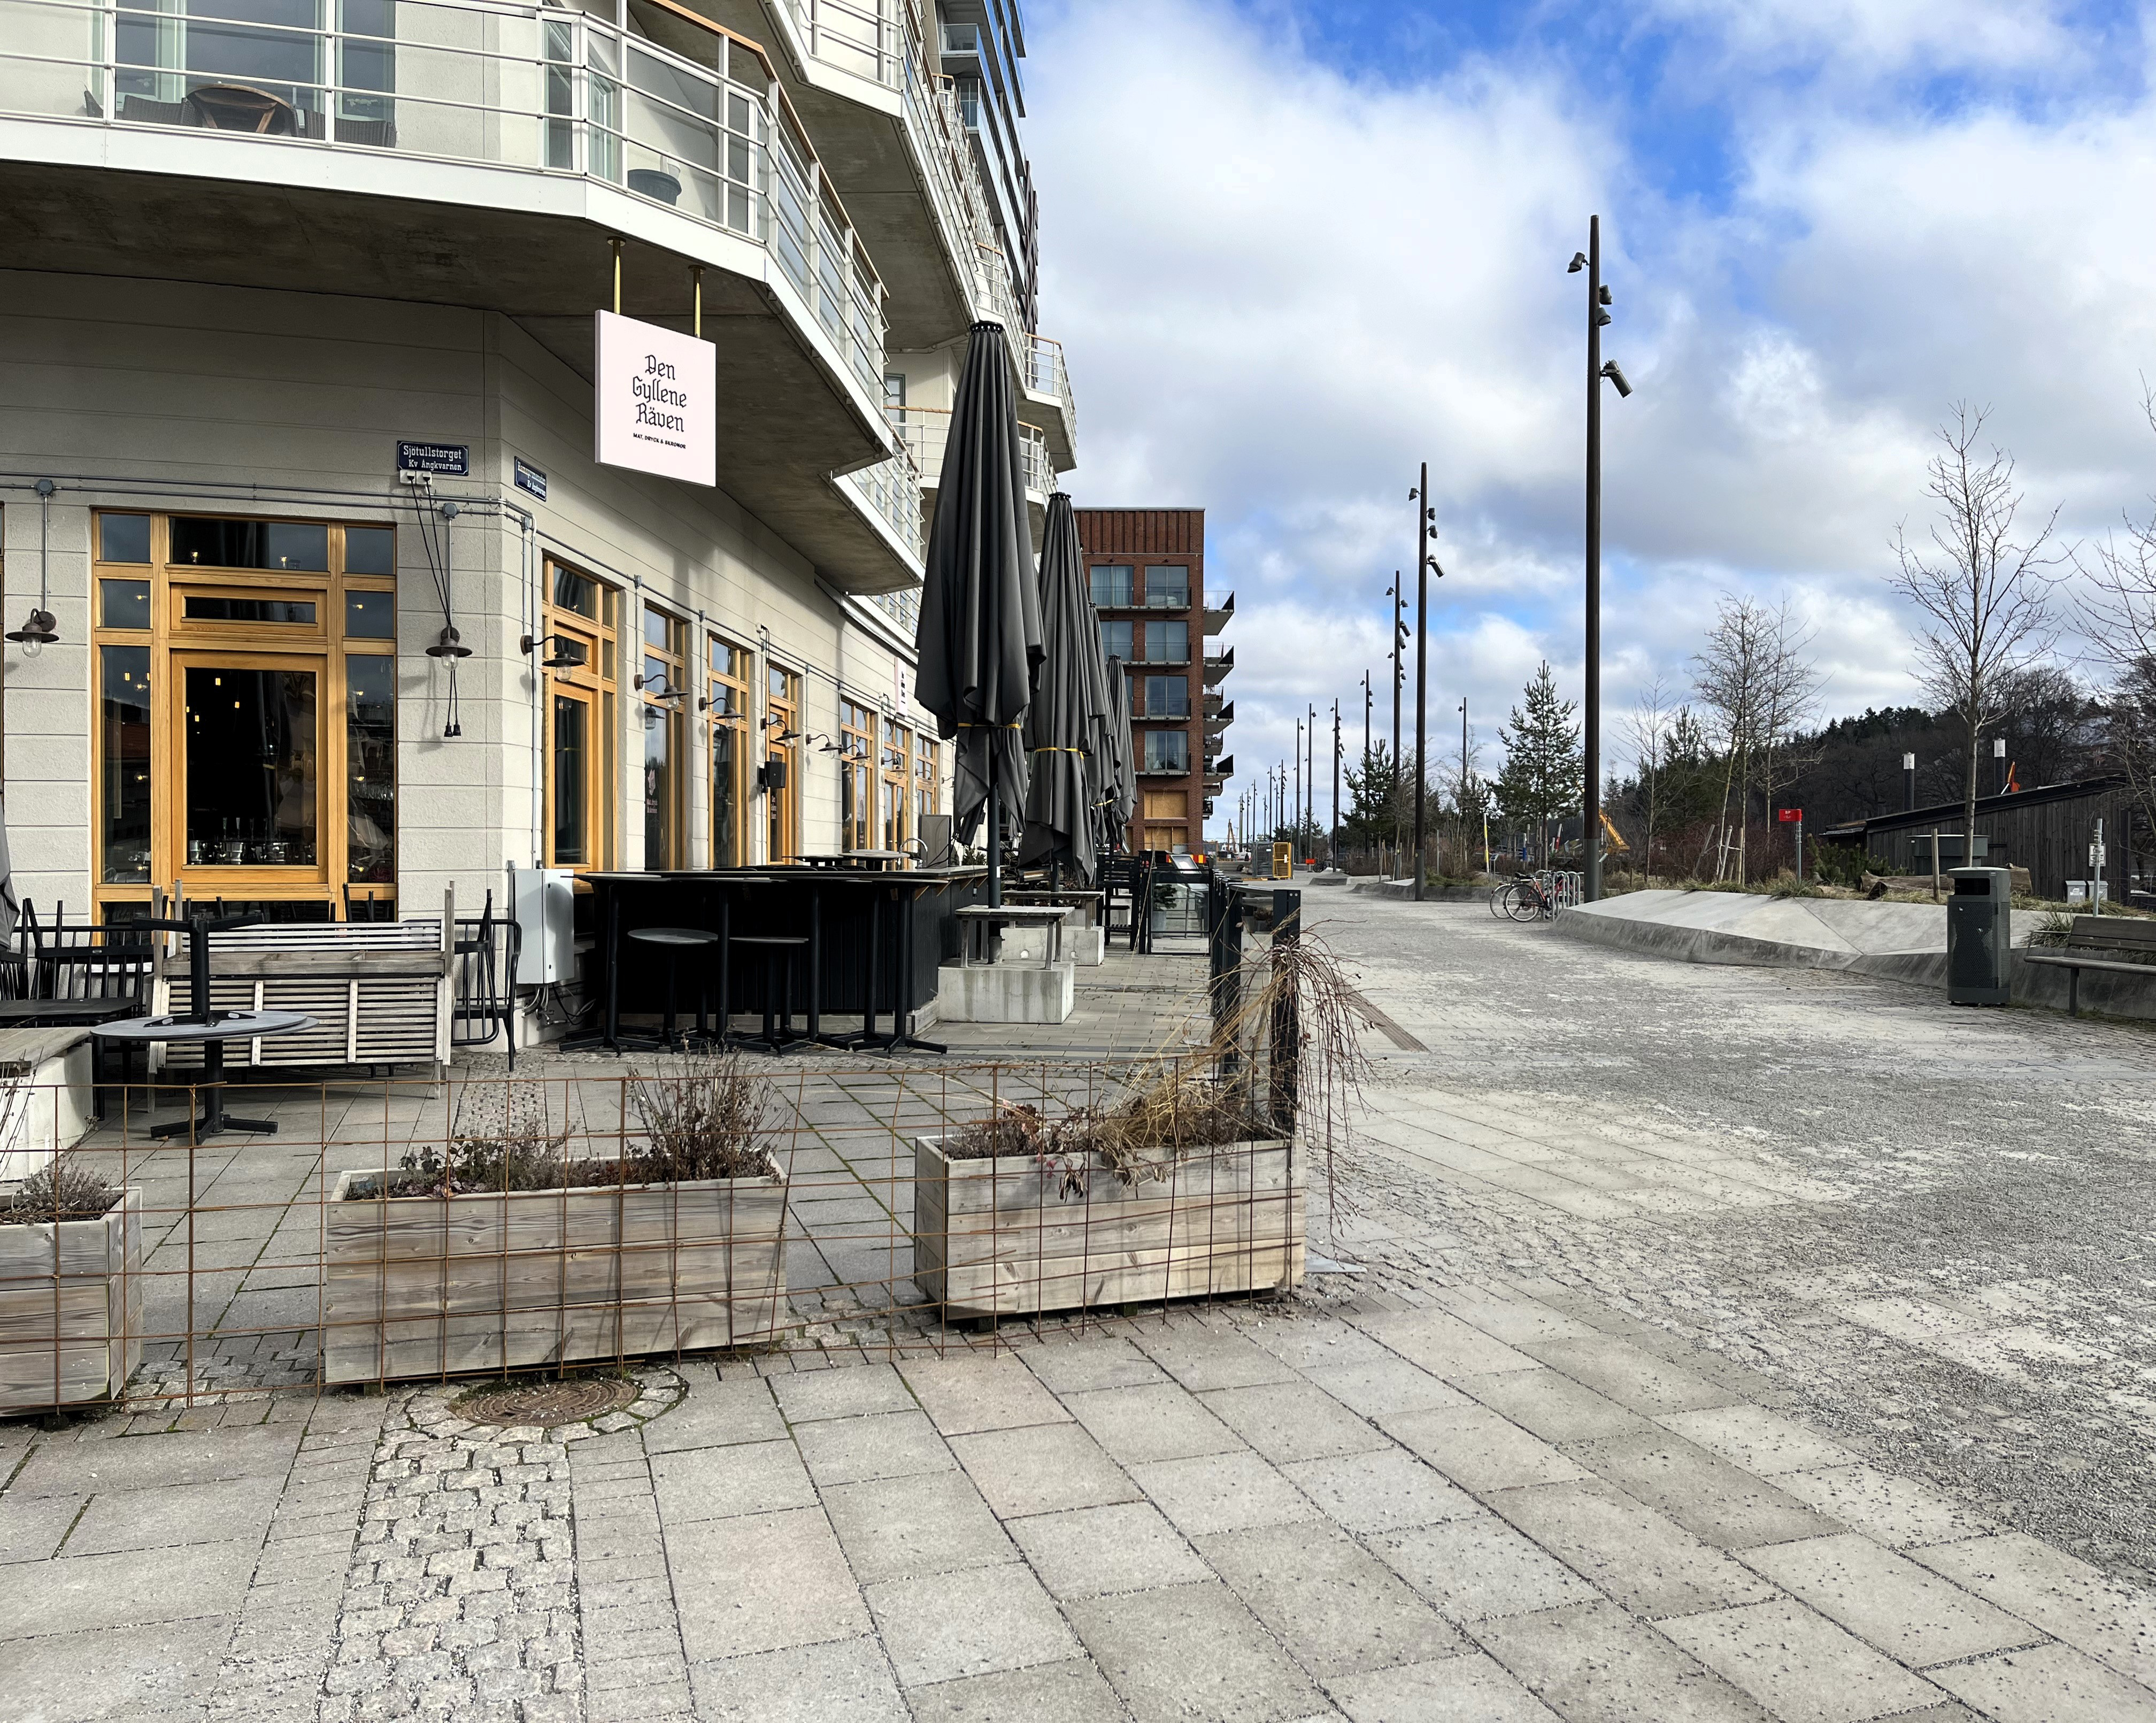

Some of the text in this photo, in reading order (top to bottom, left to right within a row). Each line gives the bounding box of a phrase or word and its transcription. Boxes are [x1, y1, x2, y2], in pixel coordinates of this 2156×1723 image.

[645, 355, 675, 380] Den
[633, 375, 687, 408] Gyllene
[635, 402, 684, 433] Räven
[645, 435, 659, 443] DRYCK
[403, 445, 461, 461] Sjötullstorget
[409, 459, 418, 467] Kv
